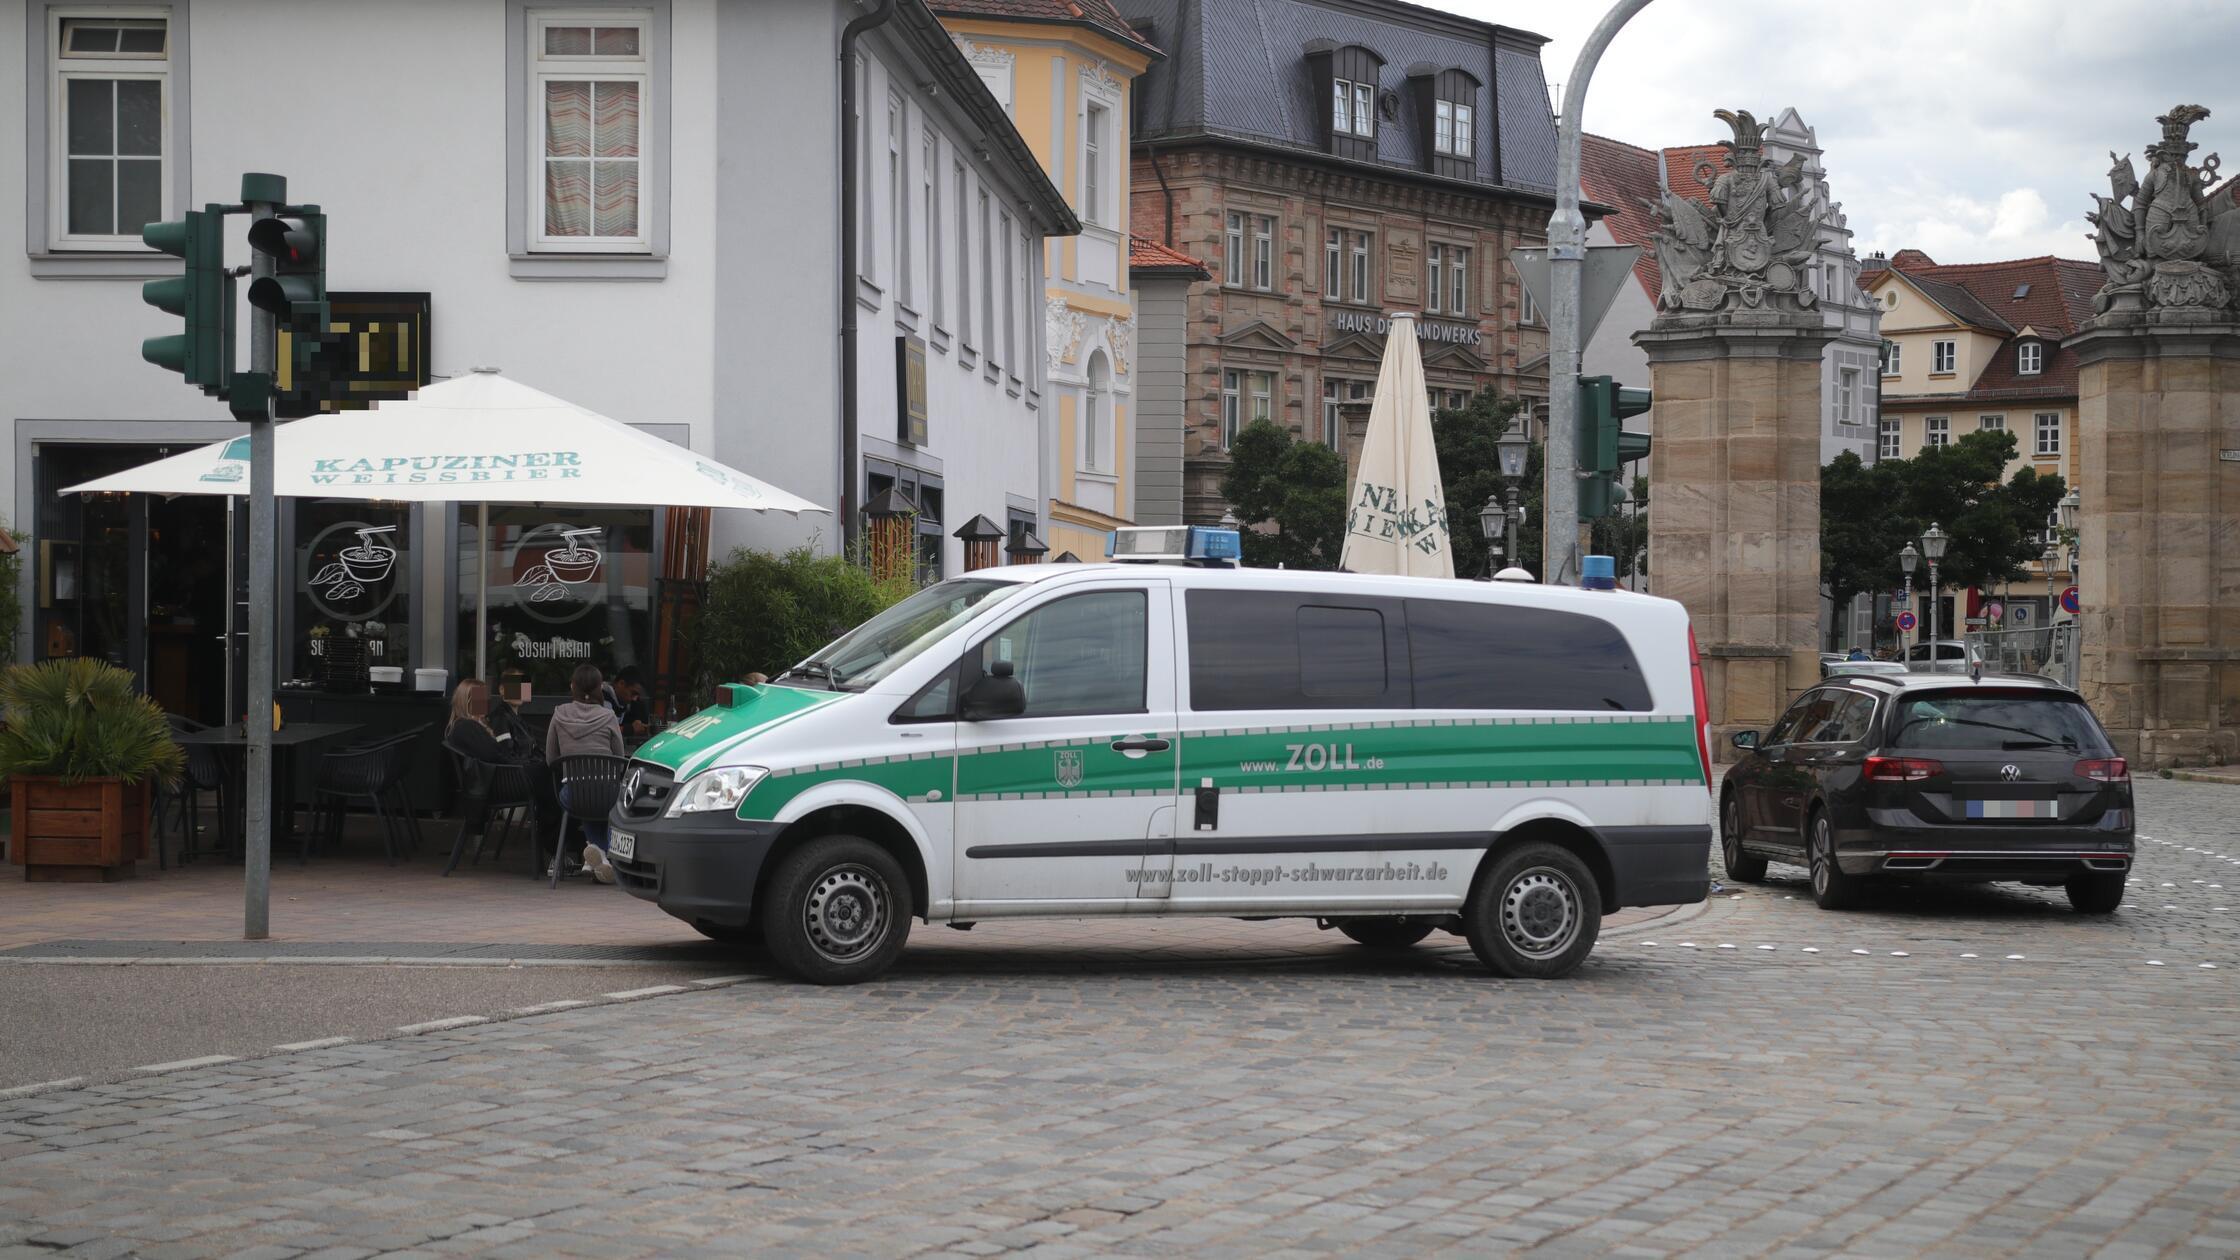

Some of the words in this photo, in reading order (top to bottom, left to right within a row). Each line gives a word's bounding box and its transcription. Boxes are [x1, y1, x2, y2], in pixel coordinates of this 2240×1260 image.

[1337, 313, 1371, 333] HAUS
[1378, 318, 1393, 335] DE
[1416, 323, 1481, 346] ANDWERKS
[311, 452, 582, 473] KAPUZINER
[310, 468, 582, 485] WEISSBIER
[518, 641, 550, 658] SUSHI
[559, 641, 591, 658] ASIAN
[1125, 862, 1448, 886] www.zoll-stoppt-schwarzarbeit.de
